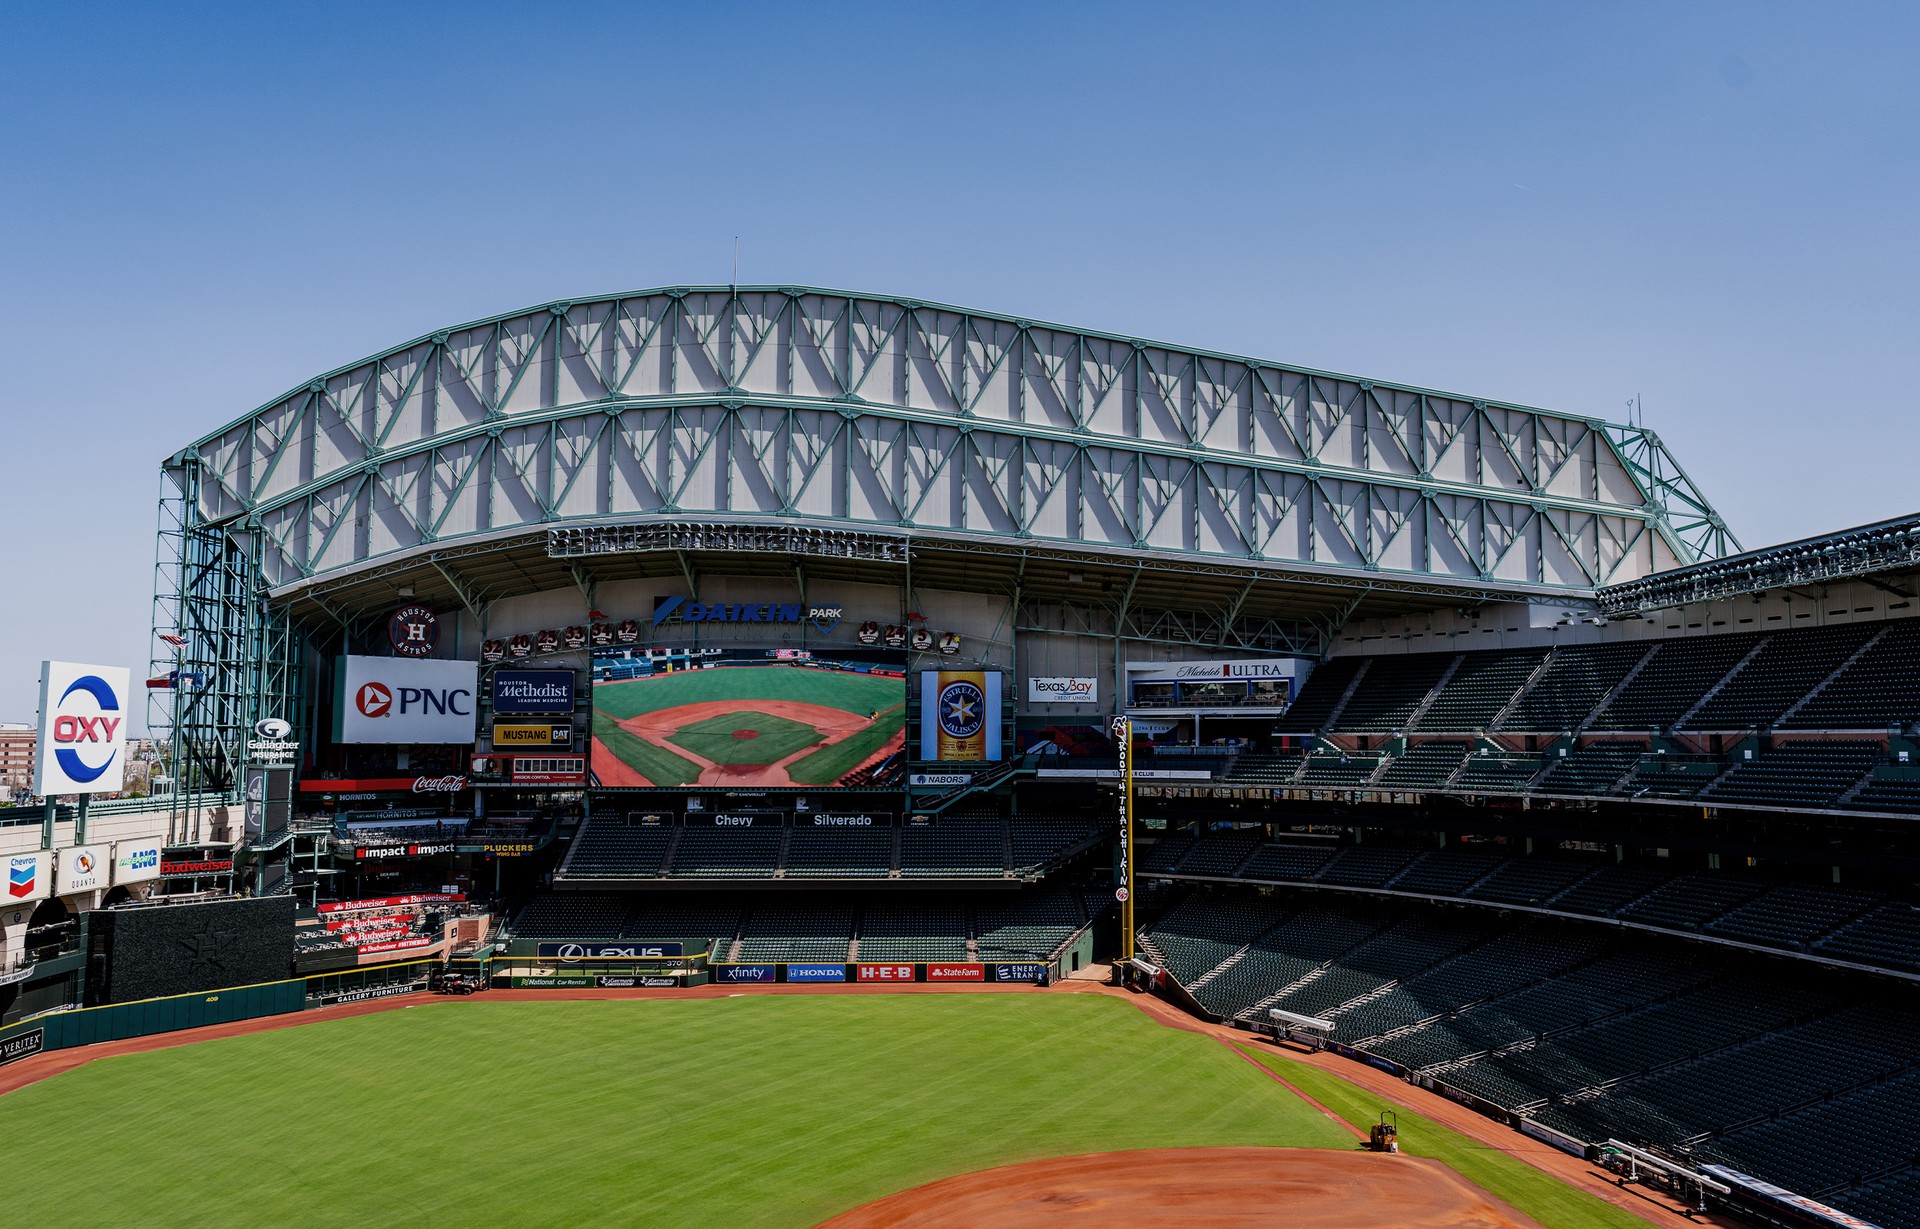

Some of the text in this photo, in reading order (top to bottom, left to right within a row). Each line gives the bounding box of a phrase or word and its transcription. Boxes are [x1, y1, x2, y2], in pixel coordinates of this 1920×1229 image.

[397, 608, 435, 623] HOUSTON
[682, 603, 842, 622] DAIKIN PARK
[407, 623, 426, 641] H
[397, 641, 432, 655] ASTROS
[1176, 664, 1282, 677] Michelob ULTRA
[499, 683, 568, 697] Methodist
[1033, 679, 1093, 695] Texas Bay
[943, 686, 981, 703] ESTRELLA
[396, 687, 471, 715] PNC
[54, 715, 121, 743] OXY
[945, 720, 979, 734] JALISCO
[503, 729, 570, 740] MUSTANG CAT
[247, 740, 300, 751] Gallagher
[412, 775, 465, 793] Coca-Cola
[928, 776, 964, 784] NABORS
[339, 793, 376, 801] HORNITOS
[376, 810, 417, 819] HORNITOS
[715, 814, 753, 827] Chevy
[814, 814, 872, 826] Silverado
[365, 846, 406, 858] impact
[417, 843, 455, 855] impact
[483, 844, 534, 852] PLUCKERS
[10, 856, 37, 867] Chevron
[132, 849, 157, 869] LNG
[161, 859, 234, 874] Budweiser
[71, 878, 96, 889] QUANTA
[410, 893, 452, 903] Budweiser
[345, 899, 388, 910] Budweiser
[353, 917, 396, 929] Budweiser
[358, 929, 402, 941] Budweiser
[367, 942, 397, 952] Budweiser
[586, 947, 663, 958] LEXUS
[728, 966, 765, 980] xfinity
[799, 969, 844, 977] HONDA
[861, 967, 911, 978] H-E-B
[528, 978, 587, 986] National Car Rental
[337, 985, 413, 1003] GALLERY FURNITURE
[4, 1034, 41, 1054] VERITEX
